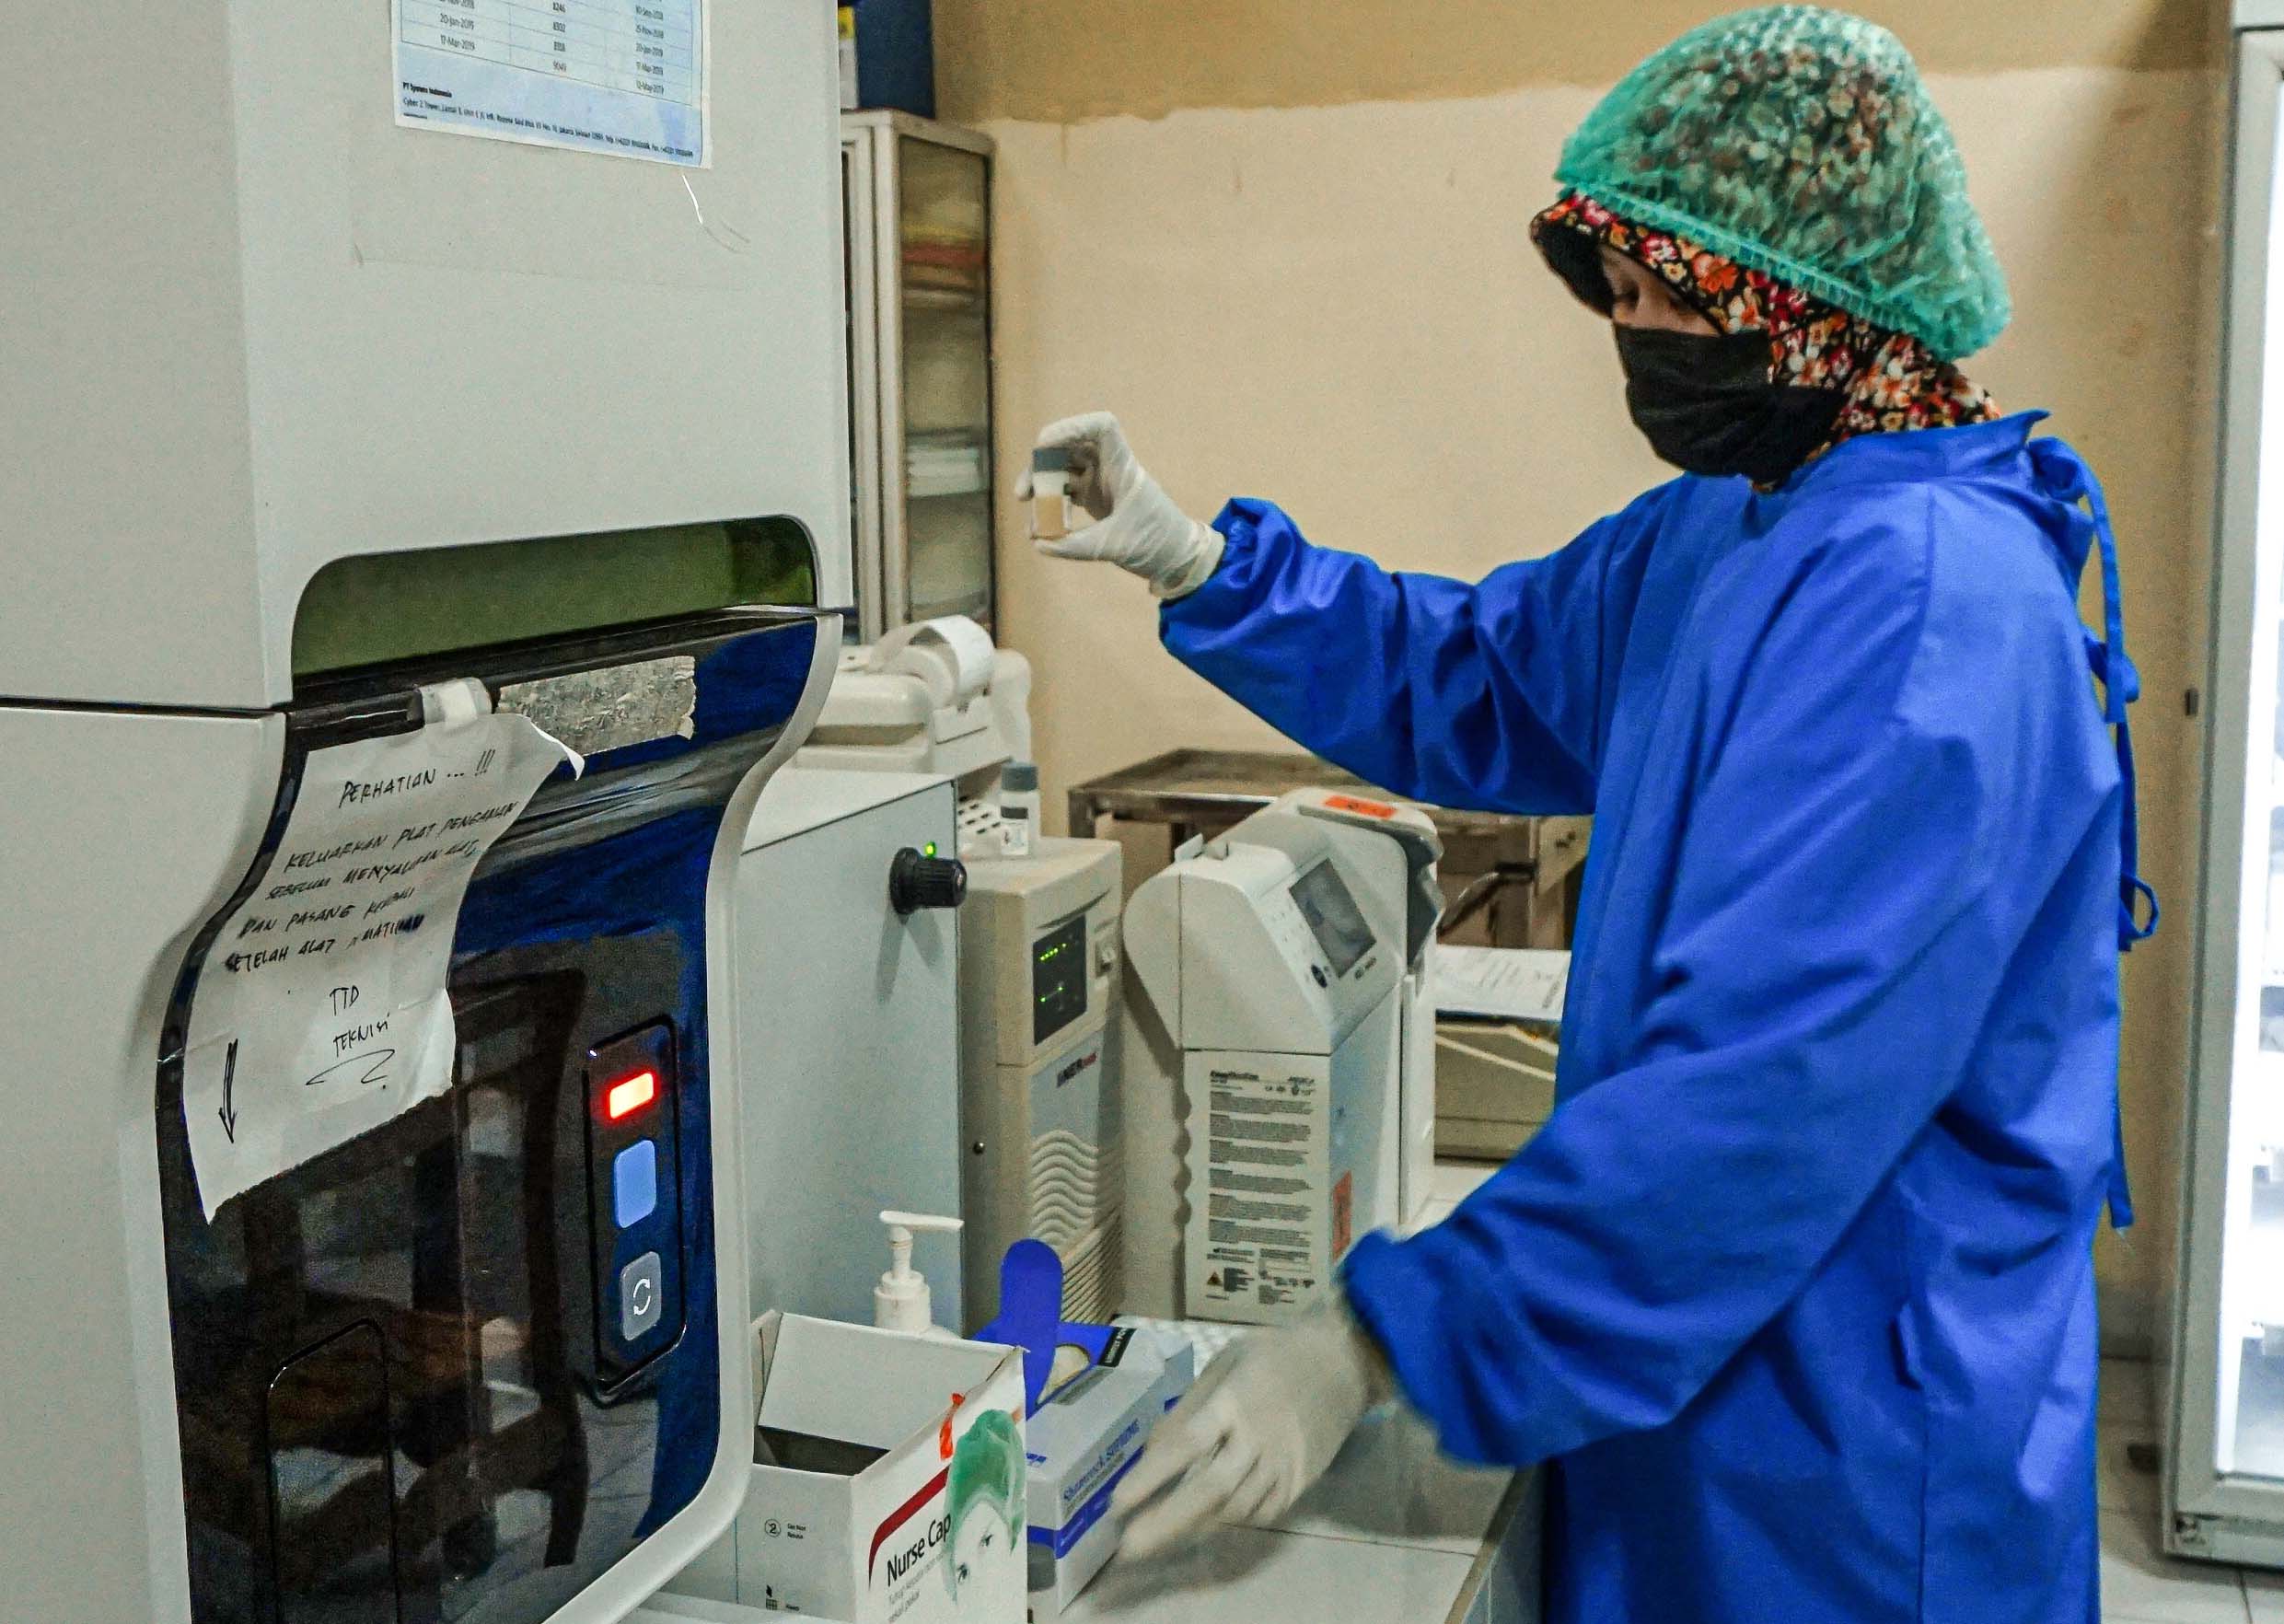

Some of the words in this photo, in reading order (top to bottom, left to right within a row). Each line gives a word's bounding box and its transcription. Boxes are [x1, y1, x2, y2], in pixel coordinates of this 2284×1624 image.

[339, 769, 436, 808] PERHATIAN
[474, 748, 496, 777] !!!
[284, 834, 388, 873] KELUARKAN
[392, 823, 436, 849] PLAT
[237, 918, 278, 939] DAN
[285, 904, 356, 933] PASANG
[329, 985, 360, 1016] TTD
[887, 1537, 925, 1587] Nurse
[928, 1514, 951, 1548] Cap
